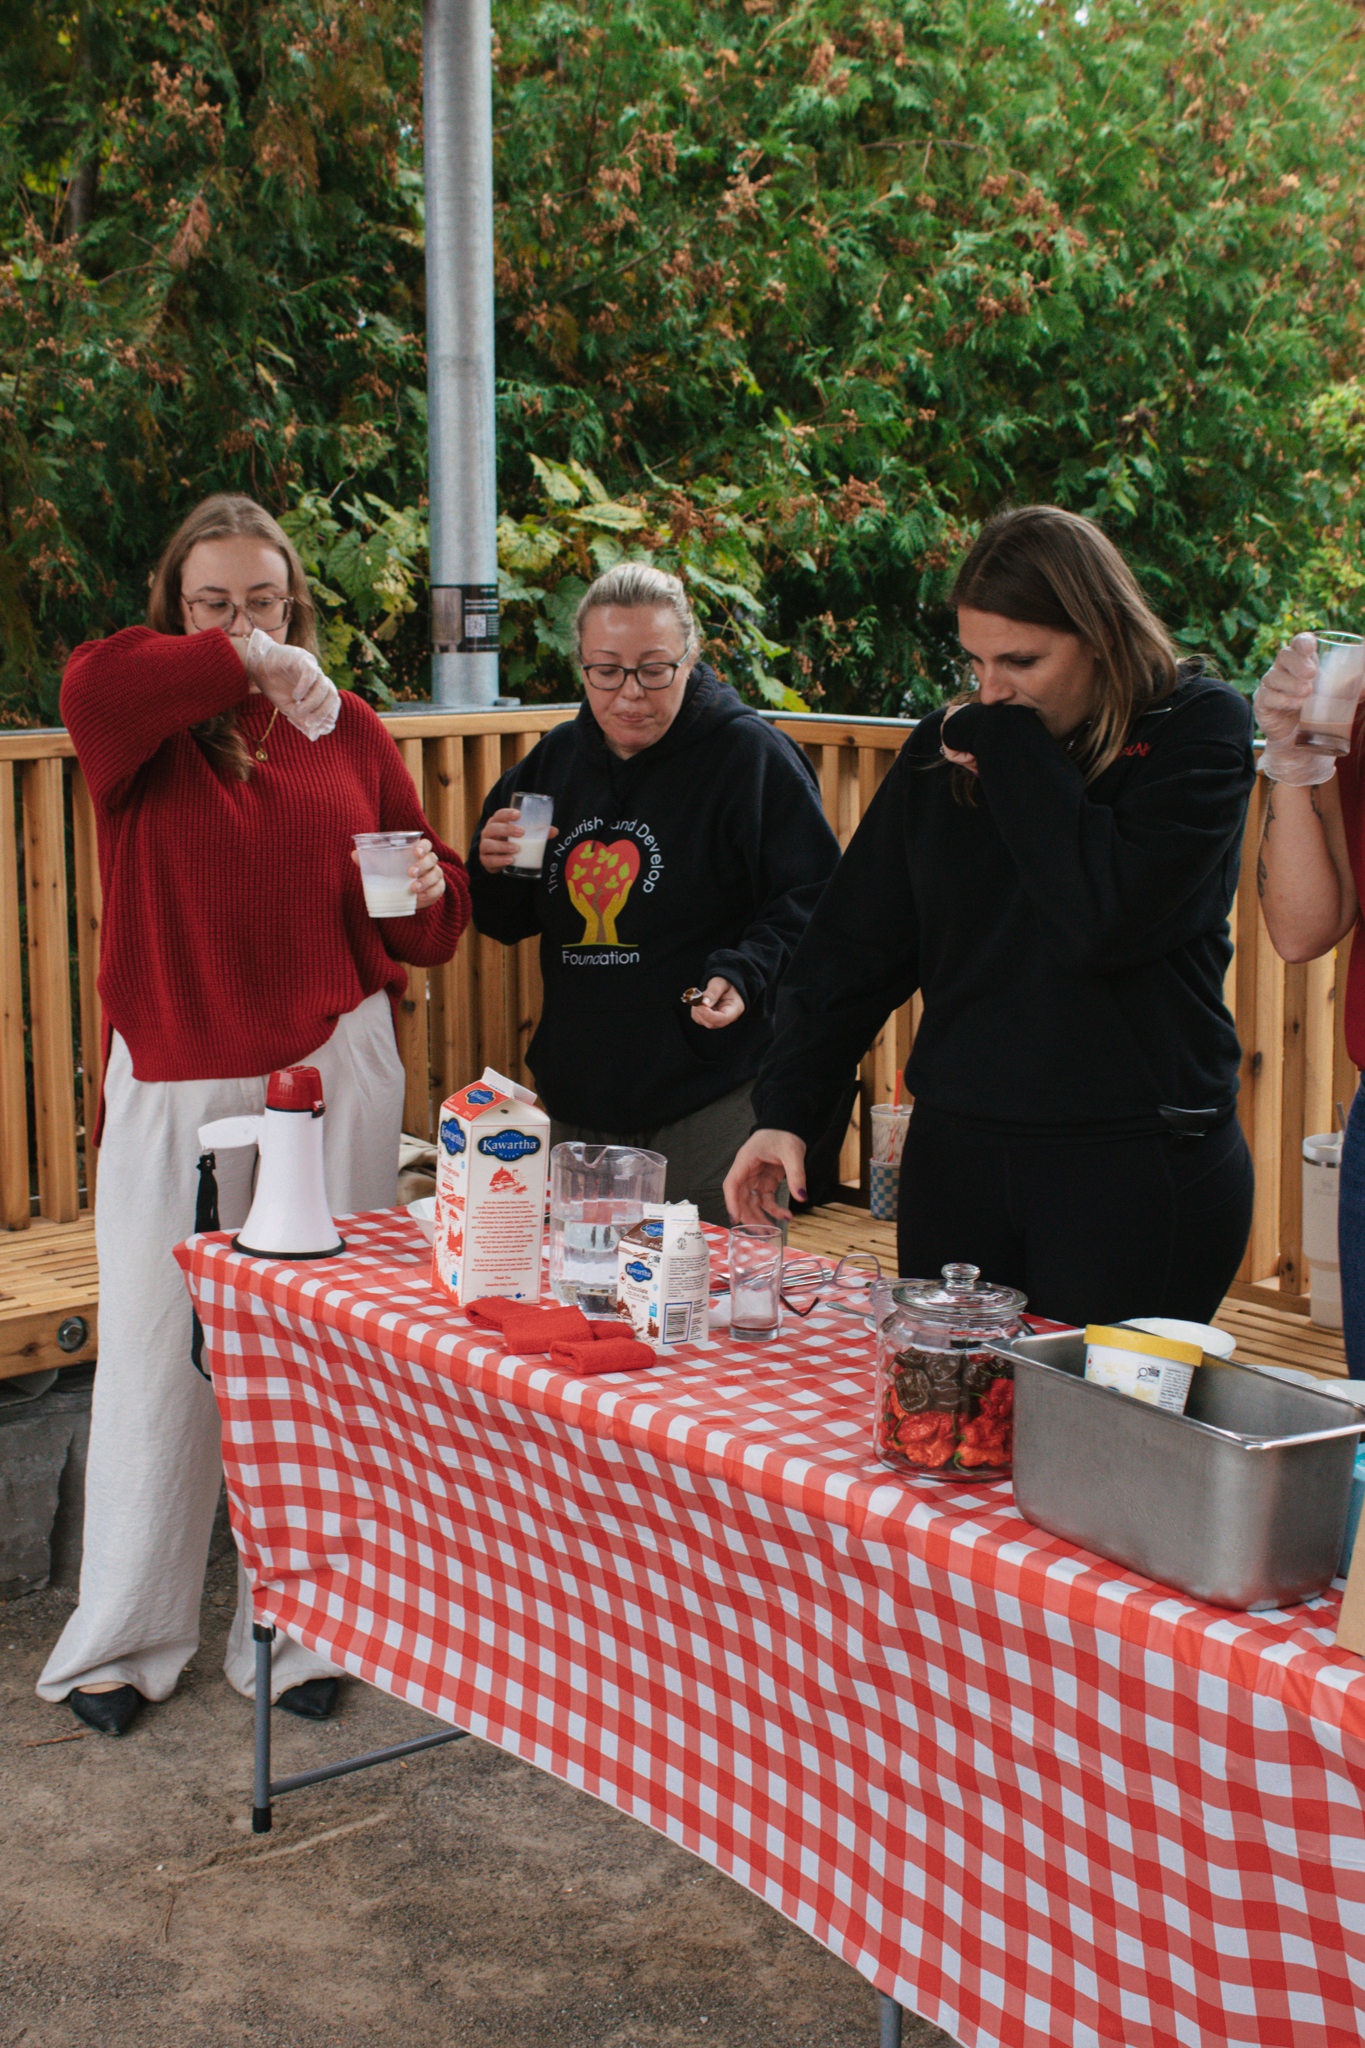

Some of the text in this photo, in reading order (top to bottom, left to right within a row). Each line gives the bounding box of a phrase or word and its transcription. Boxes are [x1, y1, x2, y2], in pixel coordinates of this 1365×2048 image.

[548, 816, 665, 894] The Nourish and Develop
[561, 950, 640, 965] Foundation
[482, 1139, 537, 1152] Kawartha
